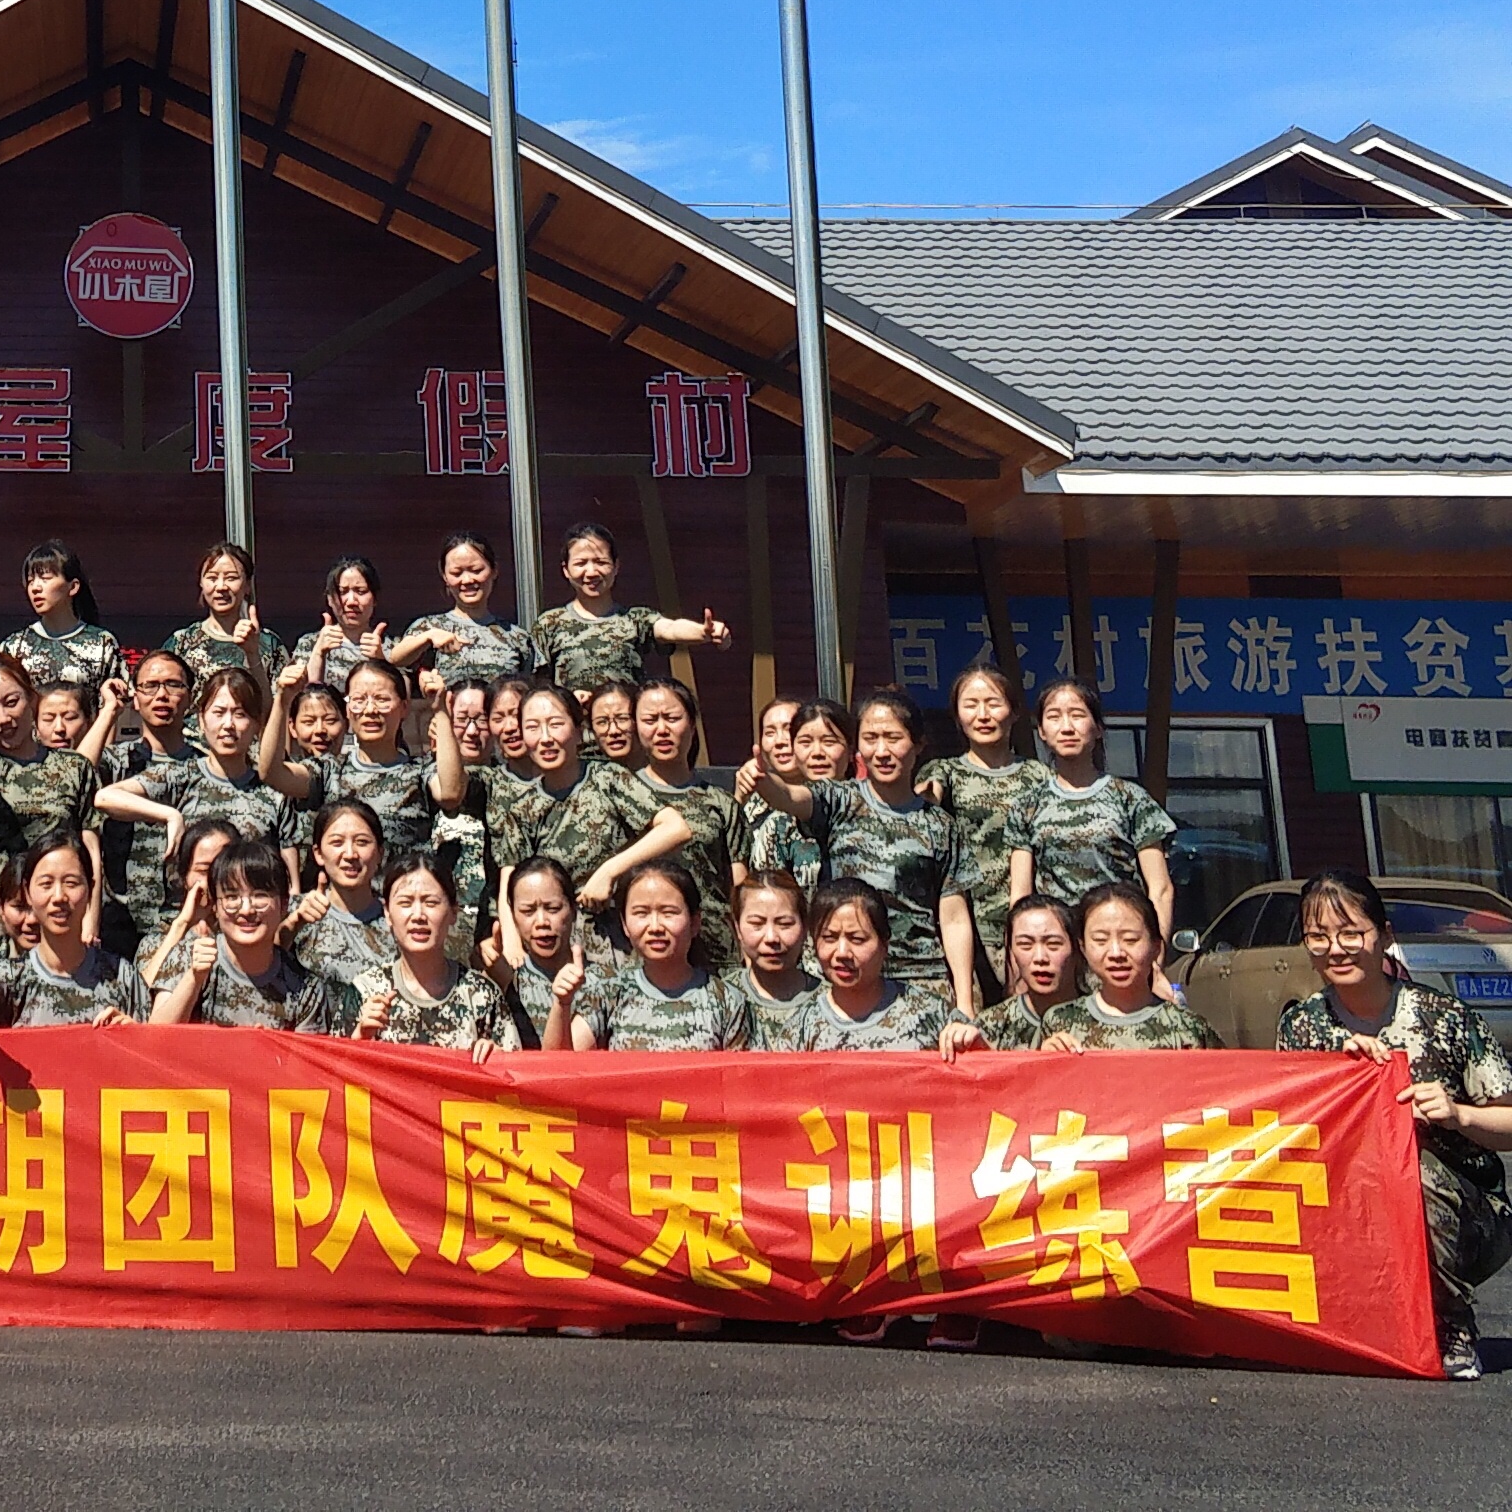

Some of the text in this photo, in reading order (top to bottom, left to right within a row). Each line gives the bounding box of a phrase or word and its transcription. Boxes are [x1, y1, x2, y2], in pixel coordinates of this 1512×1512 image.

[88, 257, 173, 272] XIAO MU WU
[78, 273, 176, 303] 小木屋
